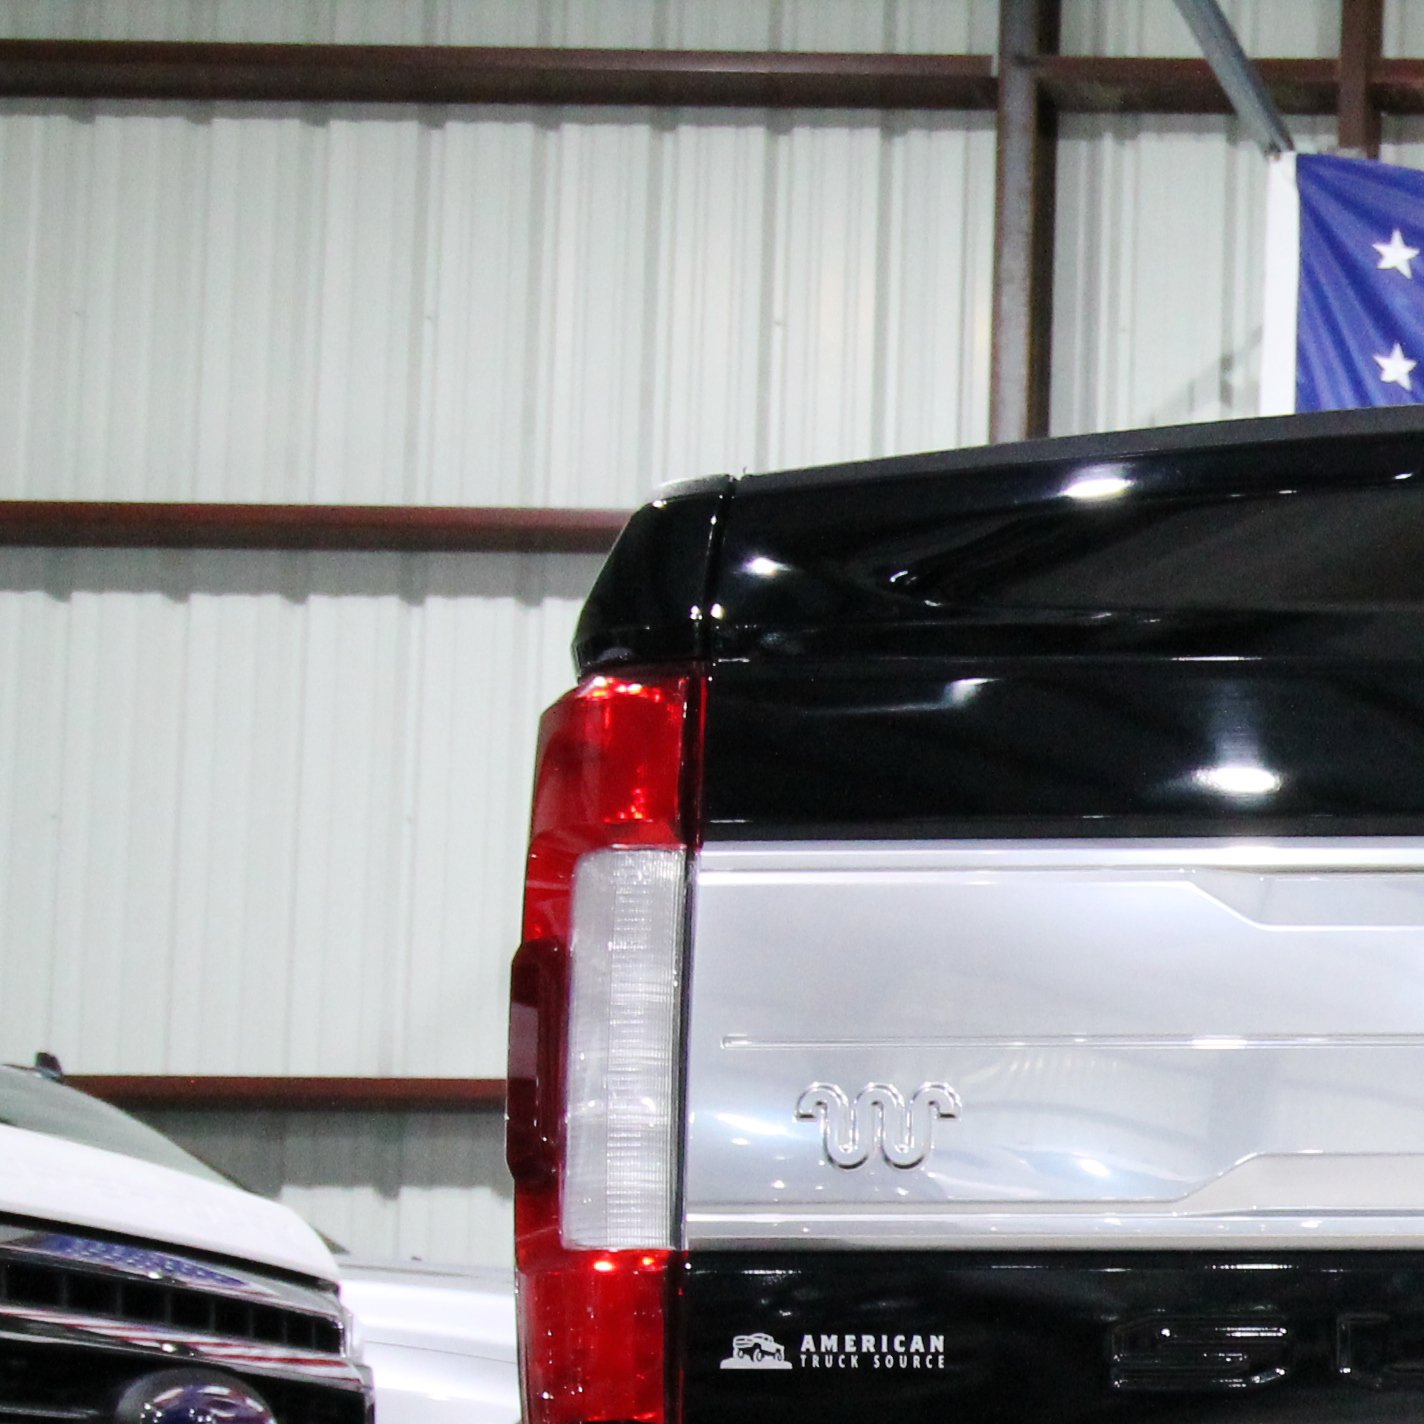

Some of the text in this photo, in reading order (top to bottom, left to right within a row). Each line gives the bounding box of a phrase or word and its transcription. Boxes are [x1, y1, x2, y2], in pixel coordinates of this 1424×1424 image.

[800, 1334, 945, 1353] AMERICAN
[800, 1354, 945, 1369] TRUCK SOURCE
